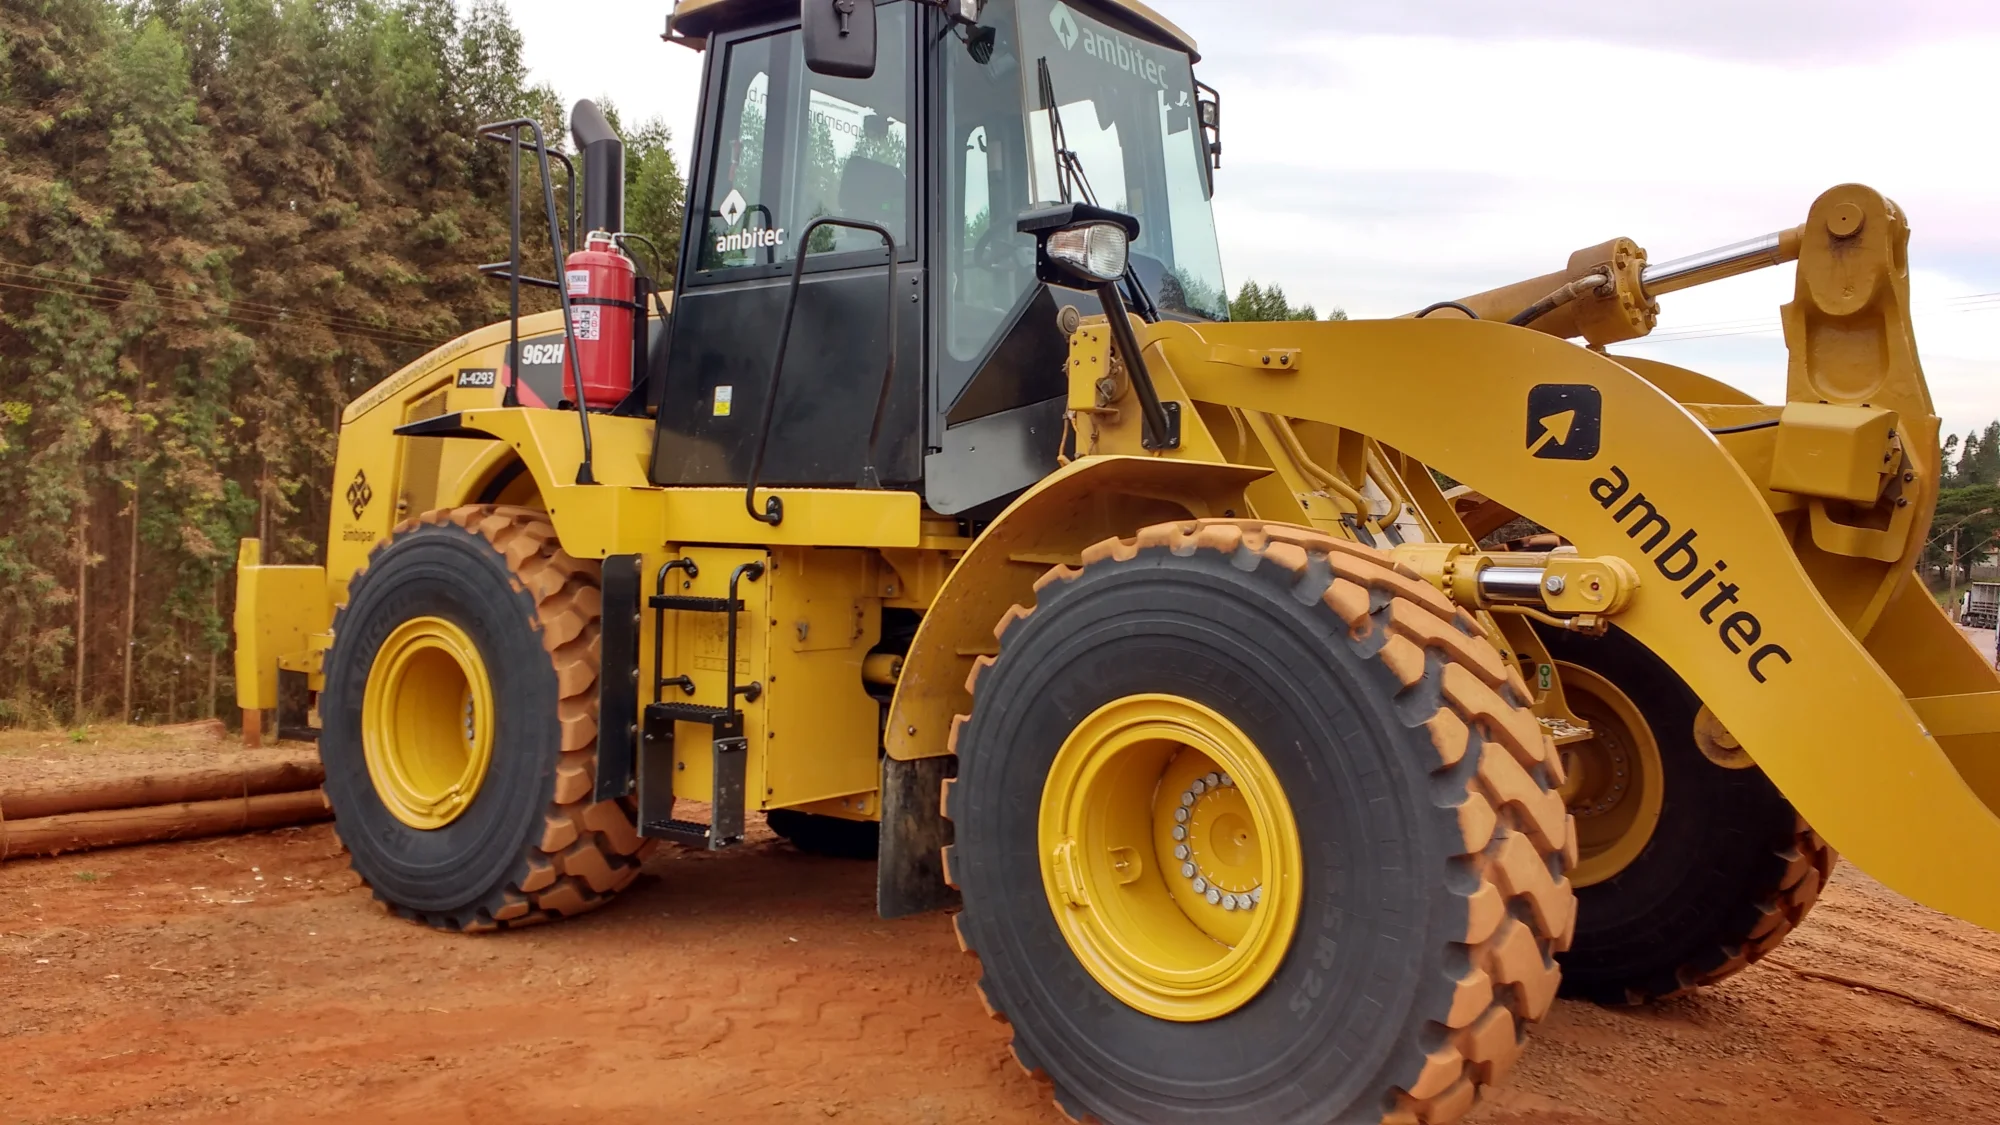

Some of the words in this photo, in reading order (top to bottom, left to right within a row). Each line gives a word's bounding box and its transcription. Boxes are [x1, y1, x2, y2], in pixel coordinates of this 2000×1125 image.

[1083, 26, 1169, 89] ambitec
[716, 227, 784, 253] ambitec
[522, 343, 565, 365] 962H
[459, 371, 494, 386] A-4293
[342, 527, 377, 545] ambipar
[1589, 465, 1793, 684] ambitec
